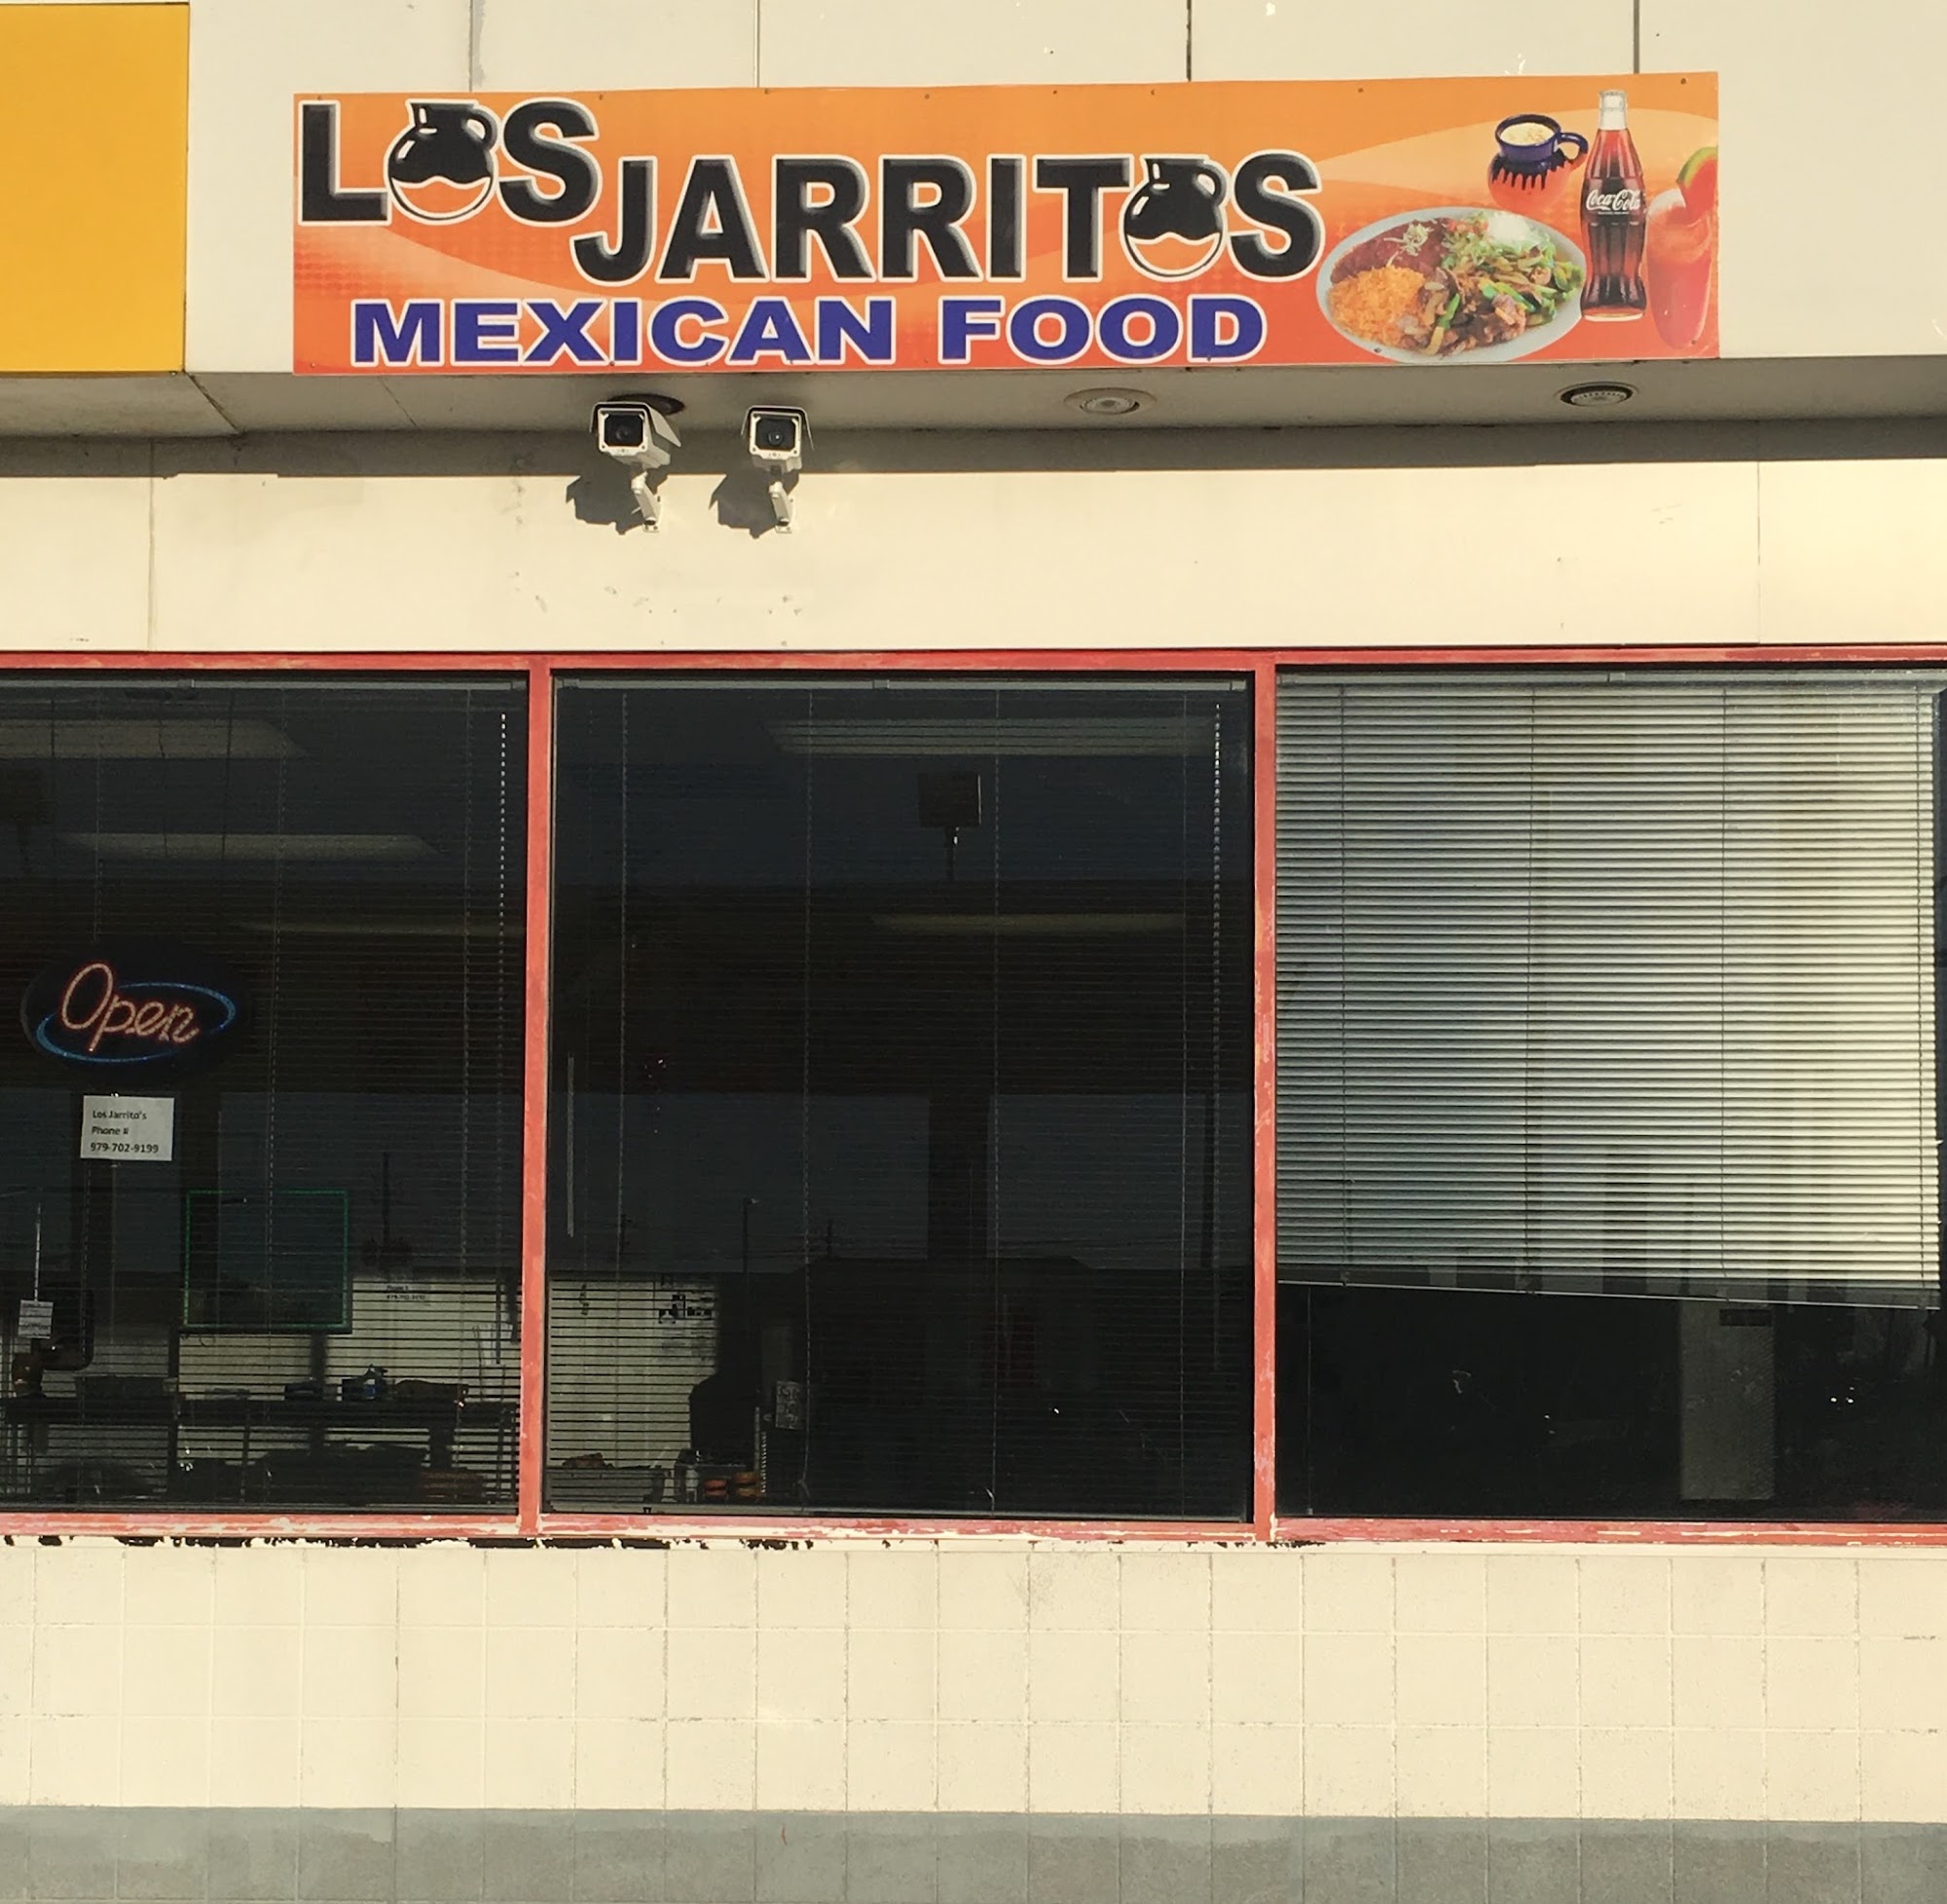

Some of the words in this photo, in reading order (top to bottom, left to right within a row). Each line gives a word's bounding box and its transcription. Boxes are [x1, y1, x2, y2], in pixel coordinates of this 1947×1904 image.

[299, 99, 602, 227] LOS
[571, 149, 1326, 286] JARRITOS
[350, 294, 896, 368] MEXICAN
[937, 293, 1267, 367] FOOD
[61, 962, 201, 1053] Open
[92, 1110, 107, 1119] Los
[109, 1110, 147, 1120] Jarrito's
[92, 1125, 121, 1135] Phone
[123, 1126, 129, 1135] #
[91, 1142, 159, 1153] 979-702-9199
